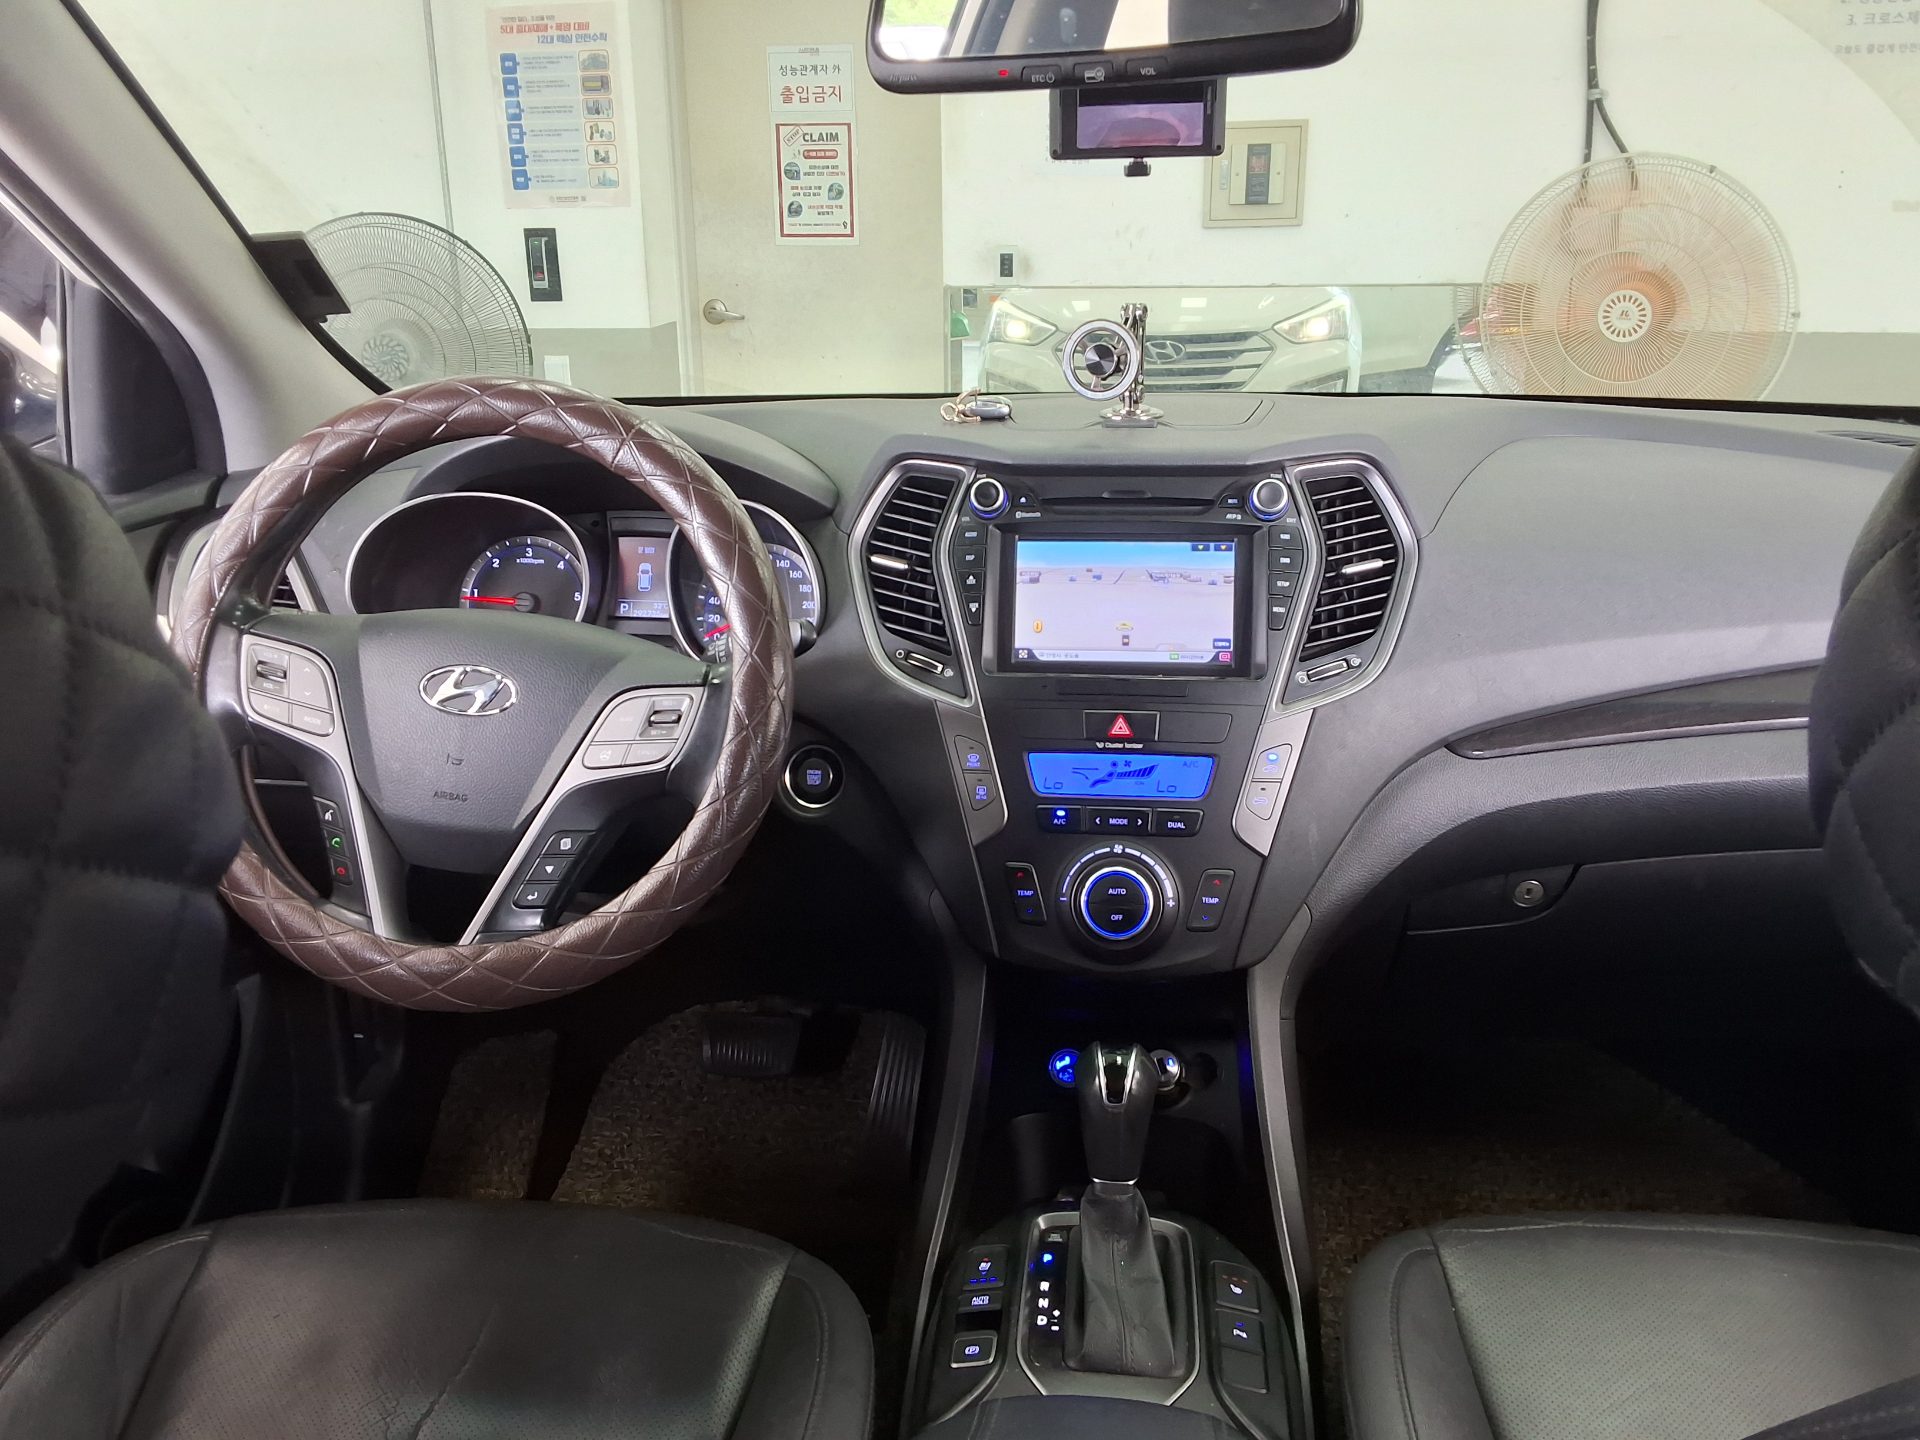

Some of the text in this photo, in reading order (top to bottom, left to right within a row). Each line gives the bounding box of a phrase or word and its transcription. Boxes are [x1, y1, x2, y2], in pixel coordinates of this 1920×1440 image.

[1140, 67, 1156, 76] VOL
[1031, 75, 1046, 83] ETC
[780, 85, 842, 104] 출입금지
[802, 132, 840, 143] CLAIM
[526, 548, 533, 557] 3
[492, 559, 500, 568] 2
[557, 560, 565, 570] 4
[776, 560, 790, 568] 140
[789, 570, 803, 578] 160
[799, 584, 812, 593] 180
[473, 589, 478, 598] 1
[574, 592, 581, 601] 5
[708, 596, 721, 605] 40
[620, 603, 629, 614] P
[708, 614, 721, 623] 20
[1182, 760, 1199, 768] A/C
[432, 791, 469, 803] AIRBAG
[1109, 817, 1129, 825] MODE
[1167, 821, 1186, 829] DUAL
[1017, 889, 1034, 897] TEMP
[1202, 896, 1219, 904] TEMP
[1043, 1254, 1053, 1263] P
[1040, 1281, 1050, 1292] R
[1038, 1297, 1049, 1309] N
[1037, 1314, 1048, 1326] D
